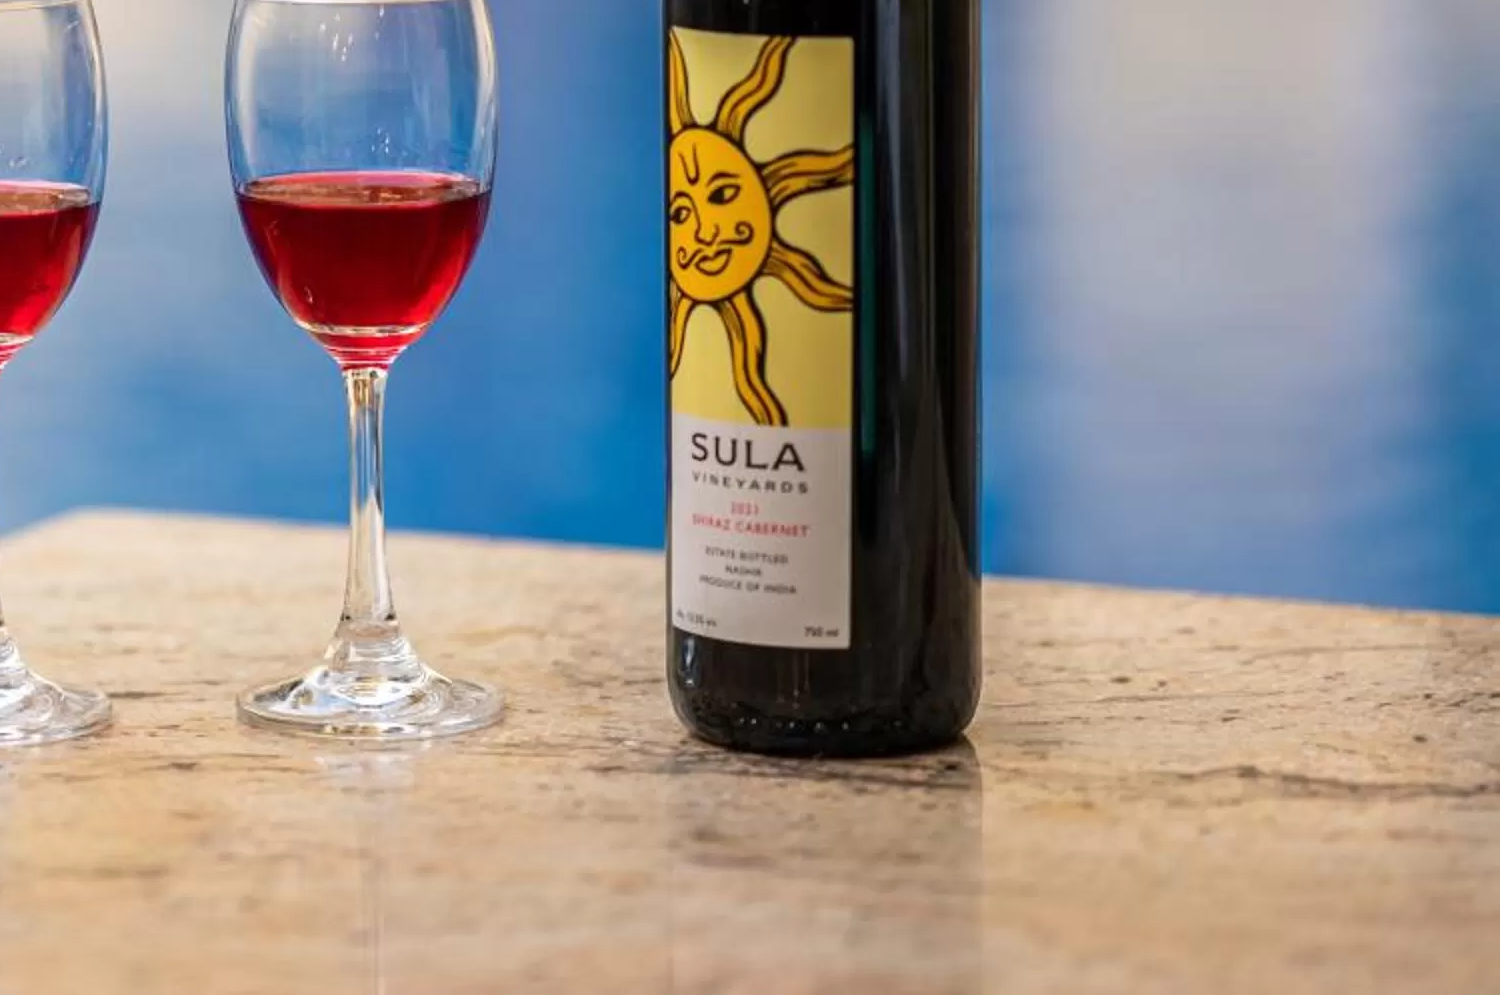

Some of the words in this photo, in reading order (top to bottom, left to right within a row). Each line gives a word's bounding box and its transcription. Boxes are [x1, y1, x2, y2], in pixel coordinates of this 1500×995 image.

[691, 432, 805, 472] SULA
[692, 470, 809, 494] VINEYARDS
[735, 520, 810, 537] CABERNET
